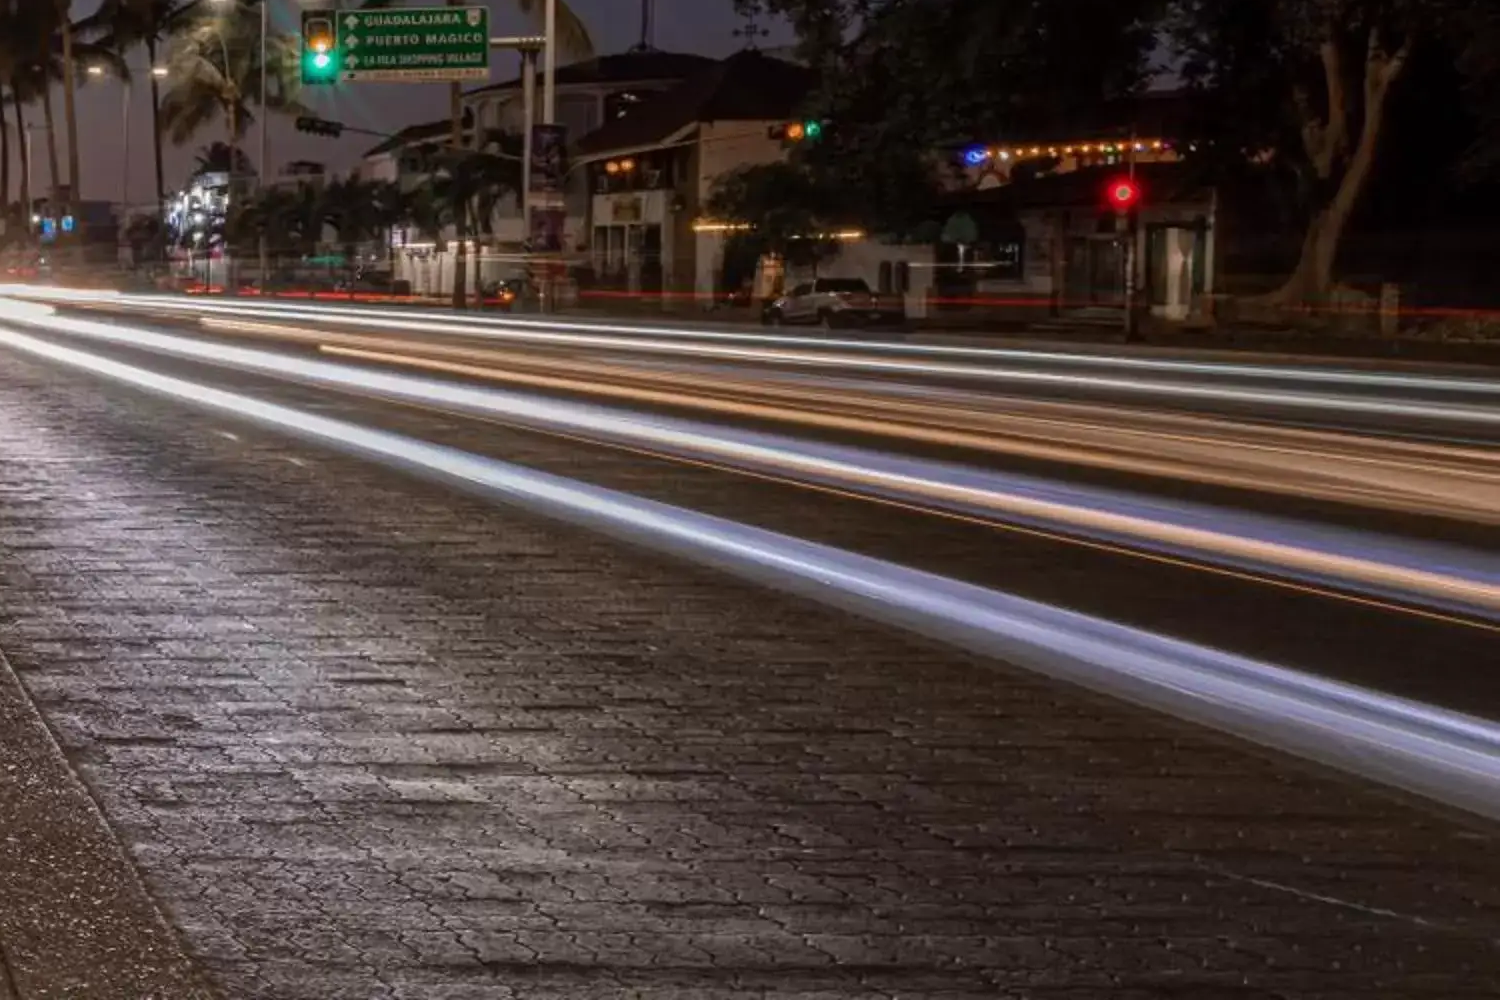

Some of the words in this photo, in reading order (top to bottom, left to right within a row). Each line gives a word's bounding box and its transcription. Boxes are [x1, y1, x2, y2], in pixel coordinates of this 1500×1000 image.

[364, 12, 460, 27] GUADALAJARA
[366, 33, 420, 46] PUERTO
[425, 31, 483, 45] MAGICO
[364, 55, 375, 67] LA
[377, 54, 396, 66] ISLA
[399, 53, 444, 66] SHOPPING
[445, 51, 483, 63] VILLAGE
